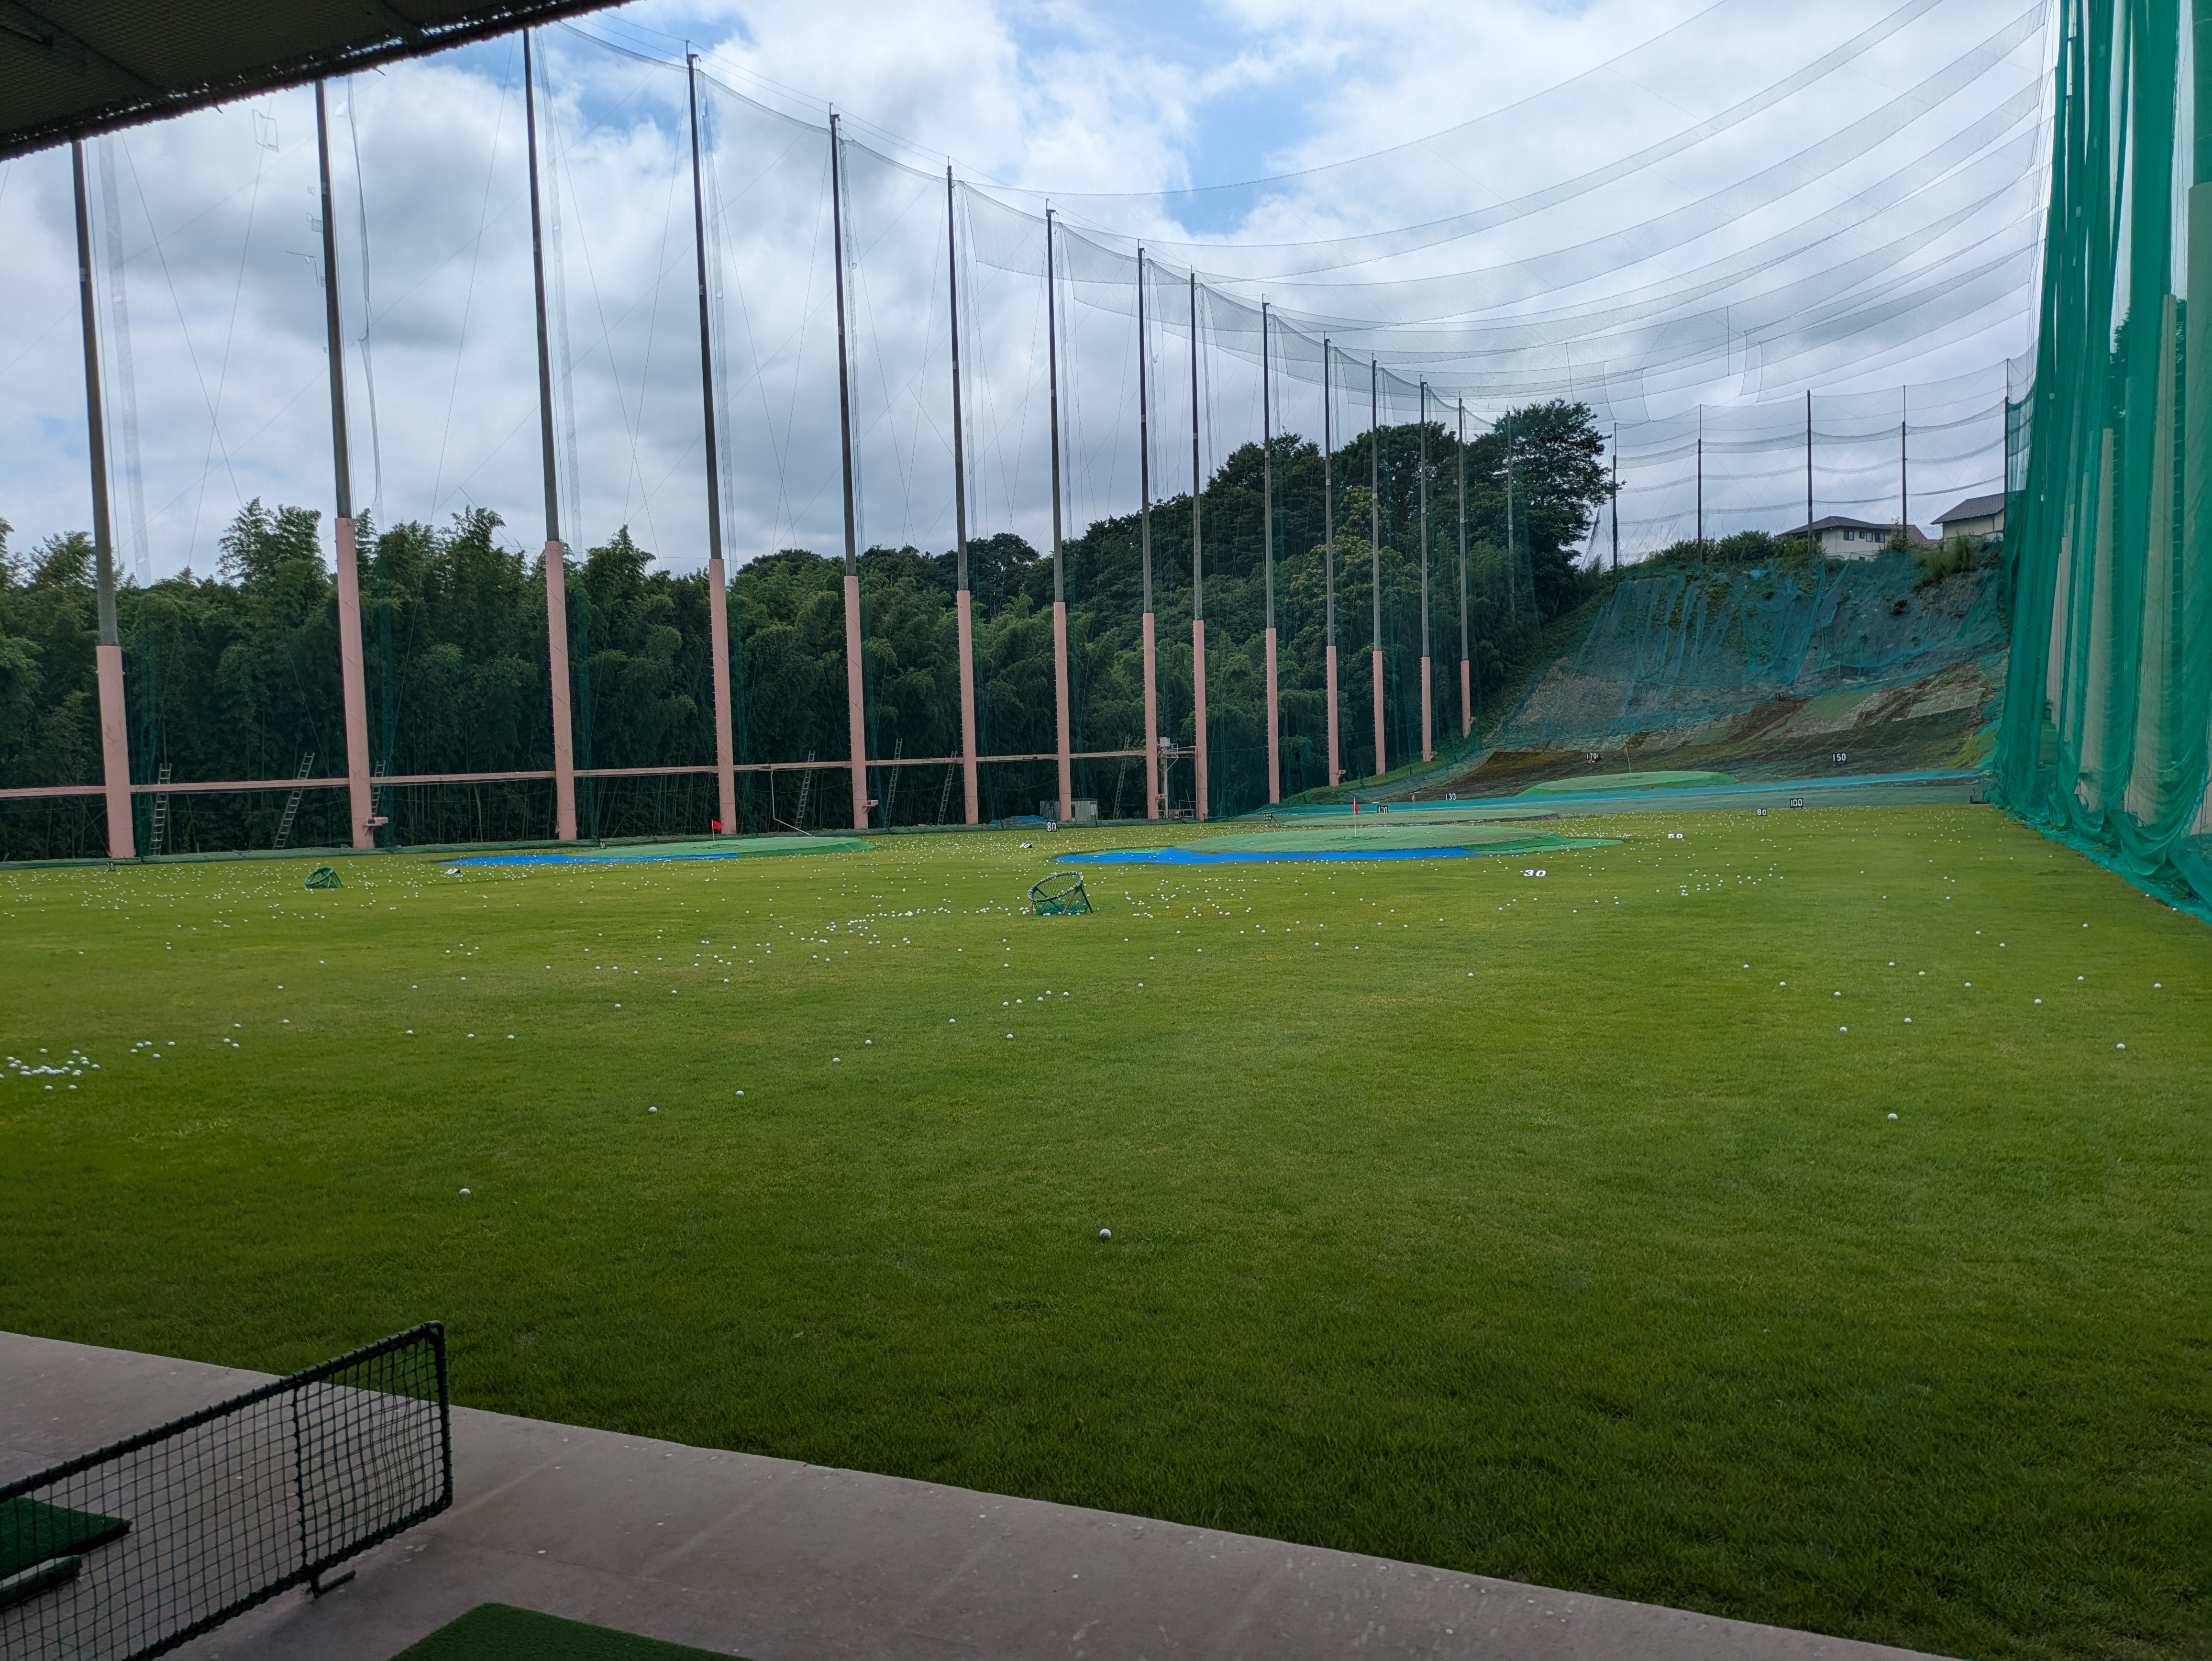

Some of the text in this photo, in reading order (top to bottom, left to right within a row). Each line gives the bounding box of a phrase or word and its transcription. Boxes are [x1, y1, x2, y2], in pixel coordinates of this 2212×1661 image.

[1833, 753, 1846, 762] 150
[1445, 793, 1456, 801] 130
[1791, 798, 1803, 807] 100
[1047, 821, 1057, 832] 80
